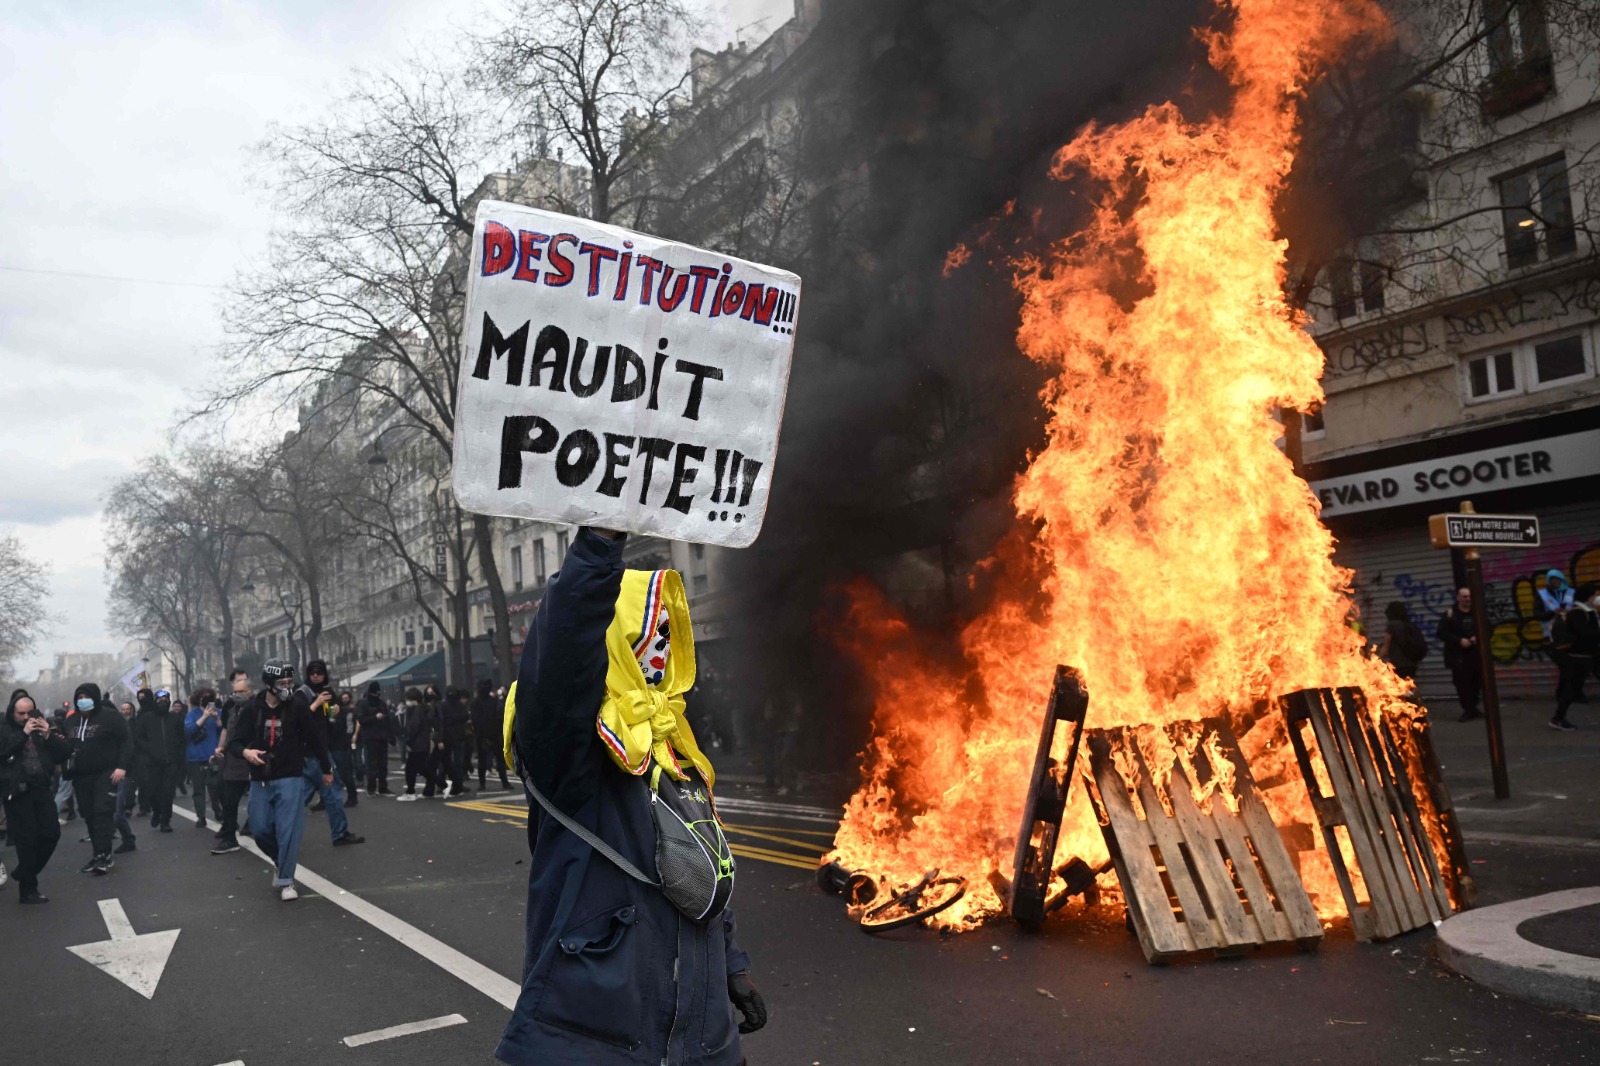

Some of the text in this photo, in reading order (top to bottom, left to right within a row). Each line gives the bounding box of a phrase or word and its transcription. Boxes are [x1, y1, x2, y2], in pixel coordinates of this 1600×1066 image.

[1318, 450, 1552, 510] EVARD SCOOTER
[1482, 520, 1501, 530] NOTRE
[1503, 521, 1520, 531] DAME
[1473, 531, 1494, 540] BONNE
[1495, 531, 1524, 541] NOUVELLE
